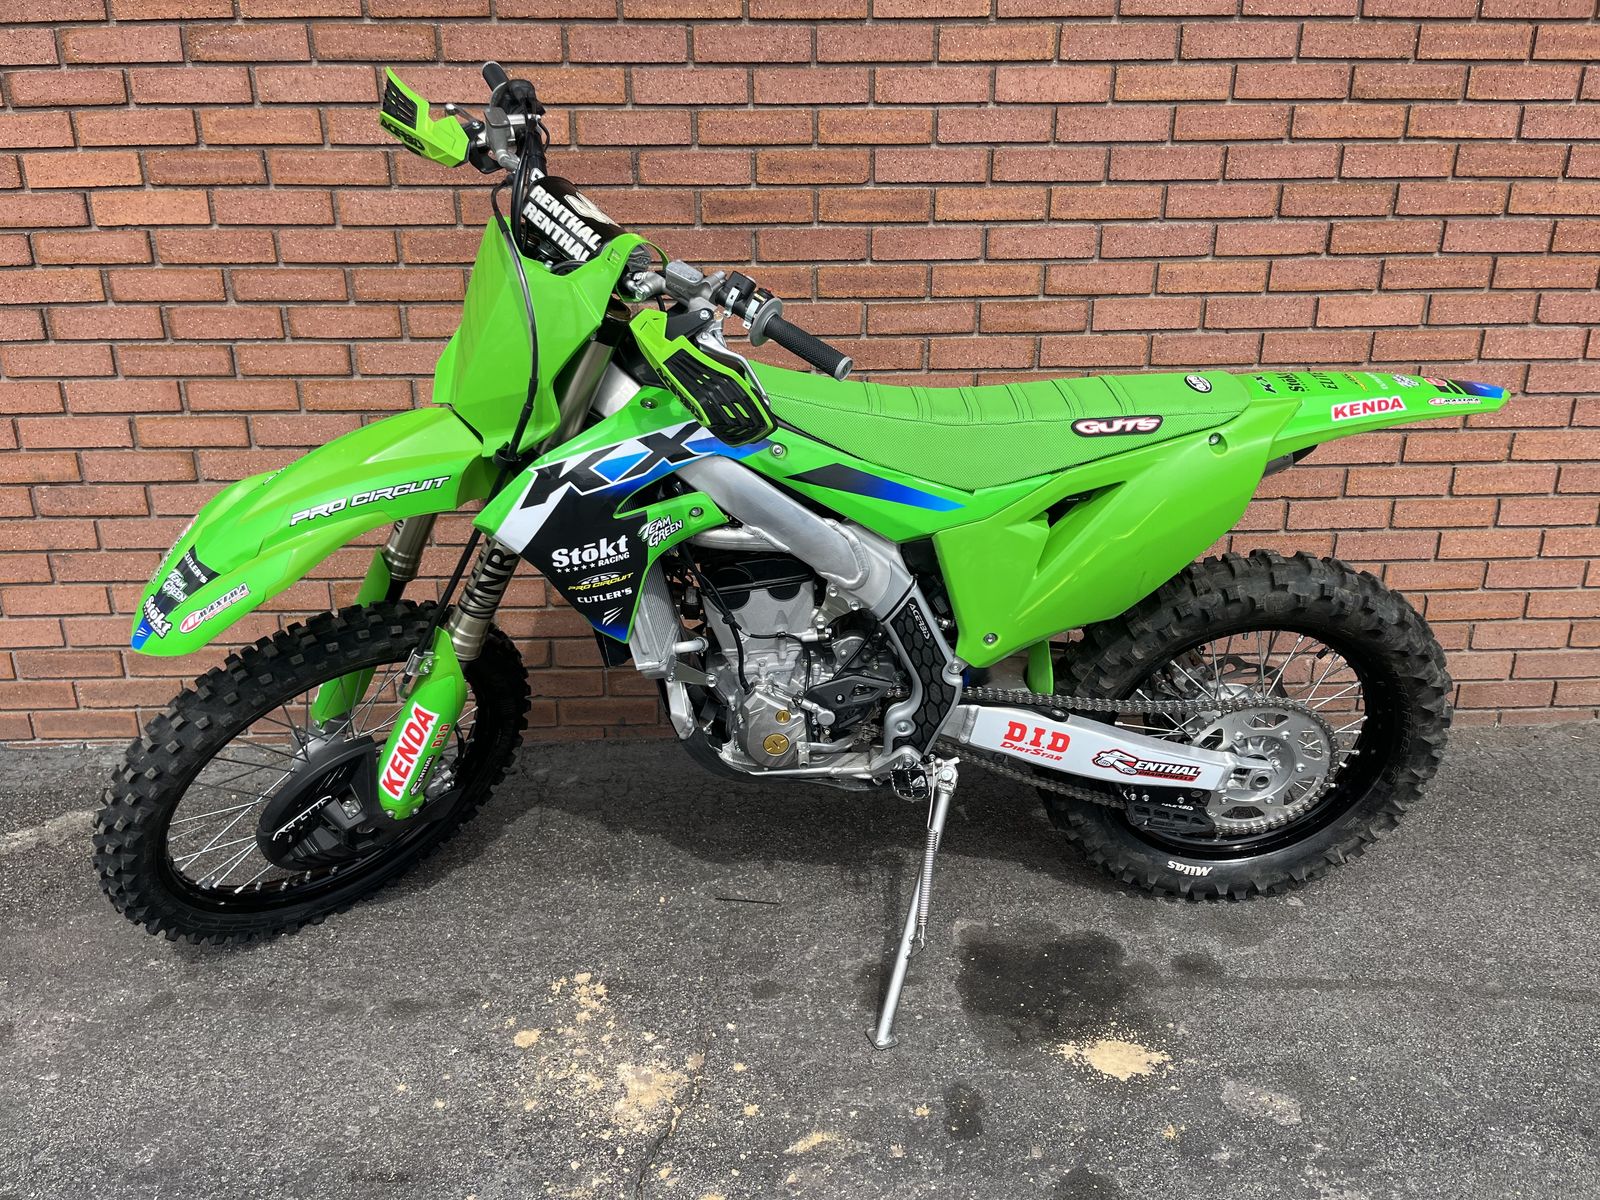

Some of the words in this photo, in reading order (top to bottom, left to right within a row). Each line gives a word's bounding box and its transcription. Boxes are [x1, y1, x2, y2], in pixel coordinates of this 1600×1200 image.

[529, 184, 602, 251] RENTHAL
[1332, 397, 1404, 419] KENDA
[1075, 416, 1161, 434] GUTS
[519, 419, 704, 510] KX
[289, 498, 348, 527] PRO
[350, 475, 452, 507] CIRCUIT
[638, 515, 672, 542] TEAM
[648, 520, 683, 547] GREEN
[598, 552, 630, 567] RACING
[567, 583, 592, 591] PRO
[592, 572, 634, 588] CIRCUIT
[577, 587, 633, 604] CUTLER'S
[382, 706, 435, 797] KENDA
[1167, 860, 1213, 877] Mitas
